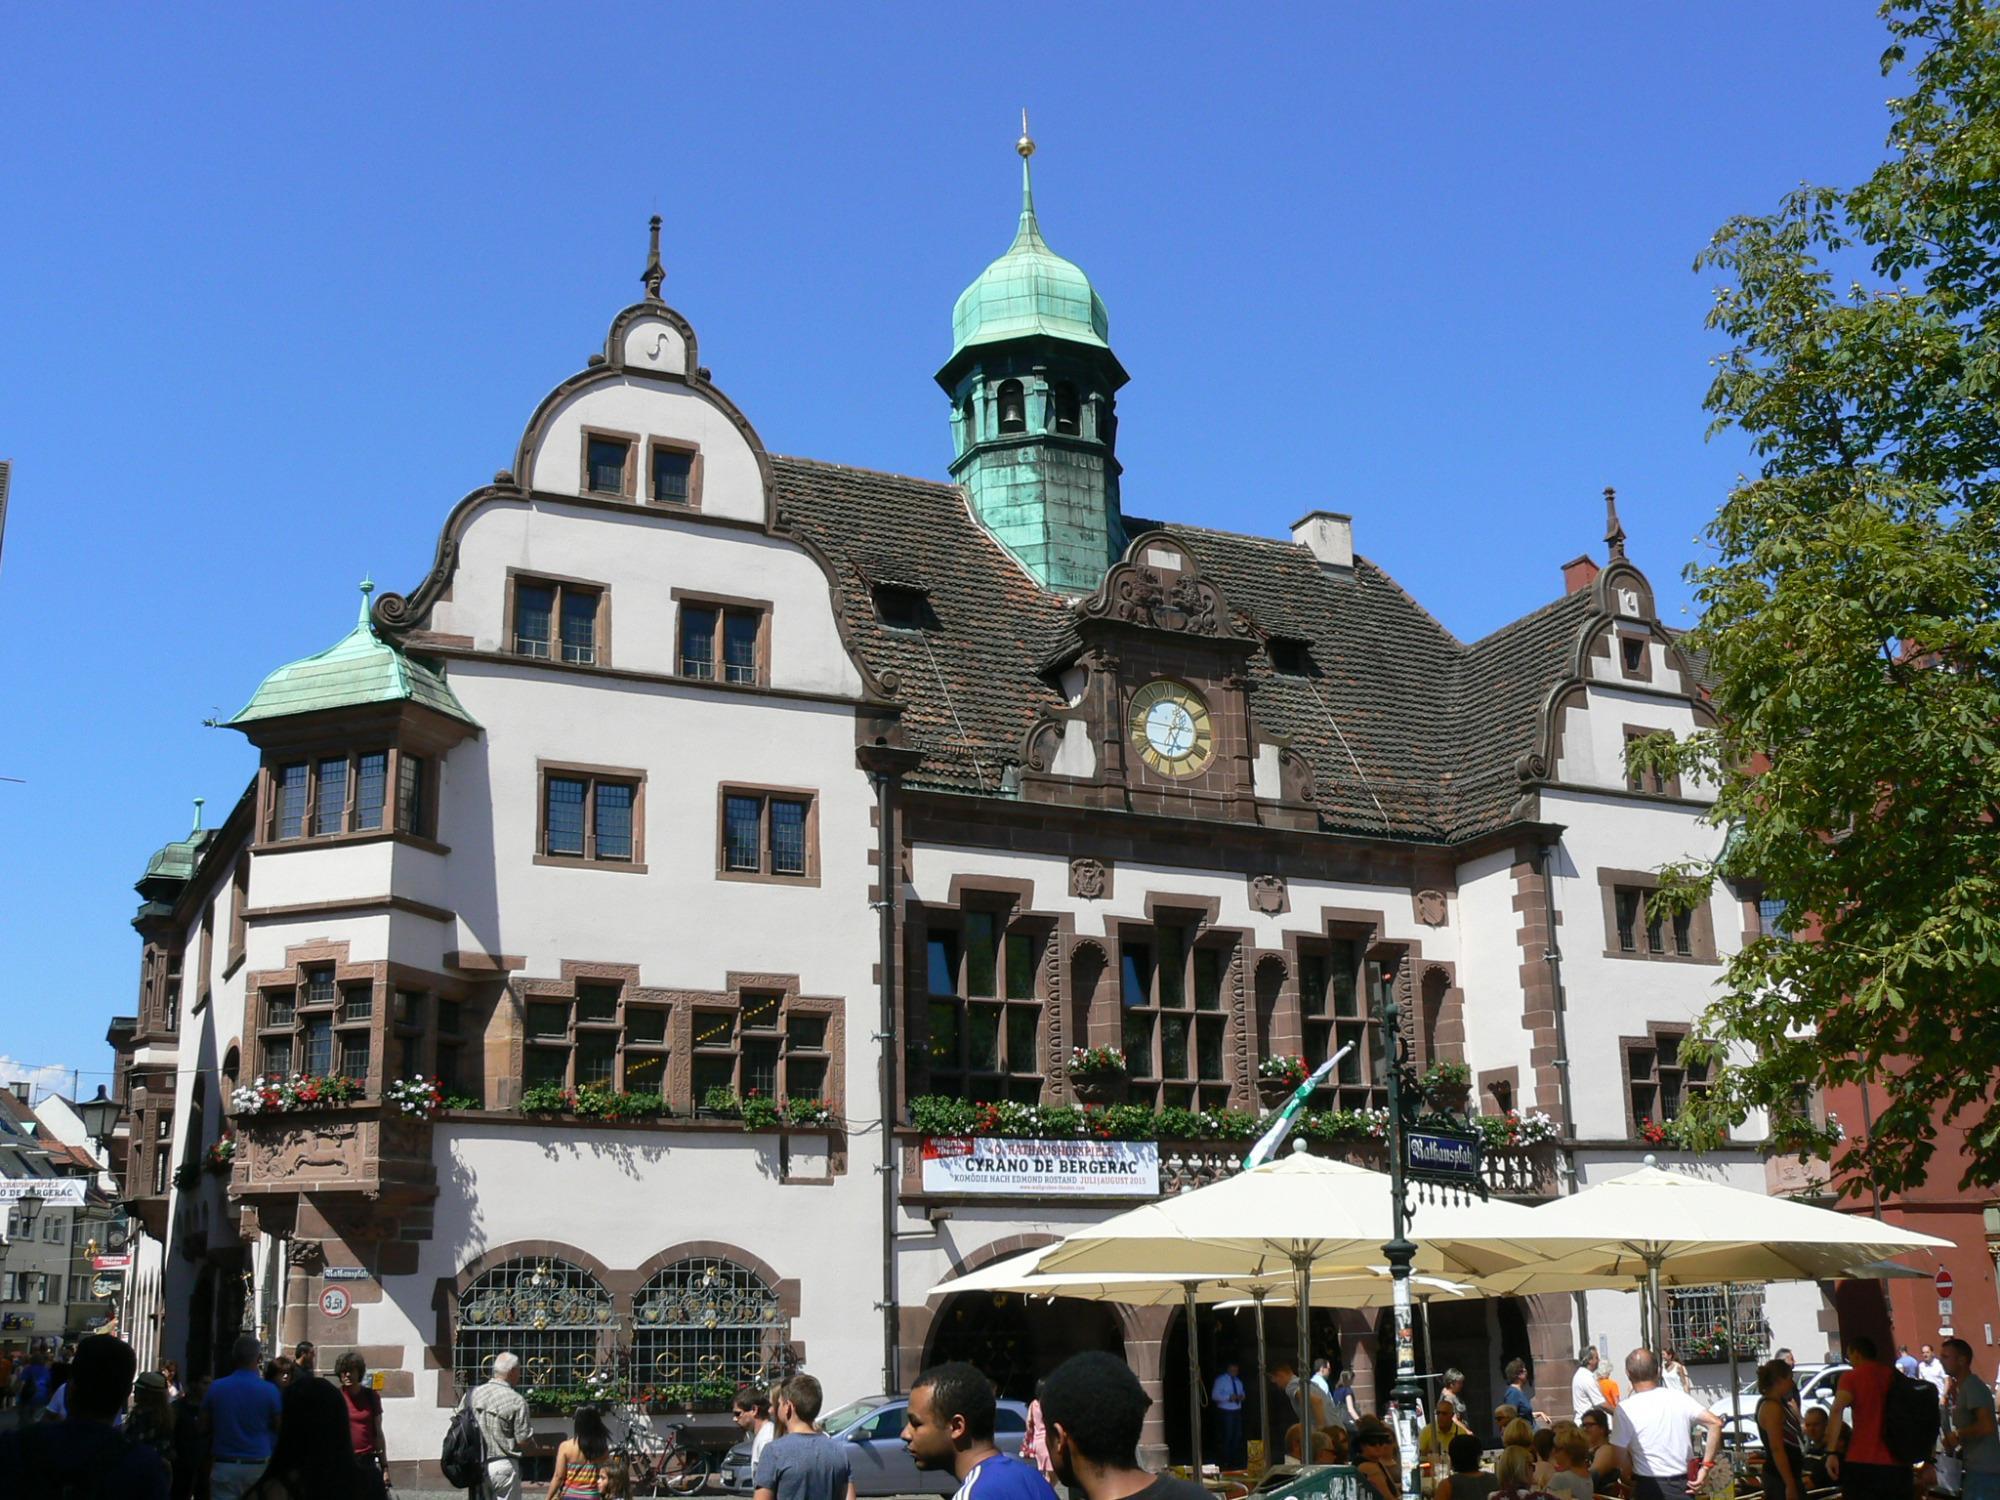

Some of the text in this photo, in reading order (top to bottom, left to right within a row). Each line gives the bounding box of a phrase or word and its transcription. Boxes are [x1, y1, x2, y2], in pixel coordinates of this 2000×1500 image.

[1008, 1144, 1114, 1158] RATHAUSHOFSPIELE
[965, 1157, 1138, 1175] CYRANO DE BERGERAC
[954, 1172, 988, 1183] KOMÖDIE
[989, 1174, 1010, 1184] NACH
[1011, 1174, 1043, 1184] EDMOND
[1044, 1175, 1078, 1185] ROSTAND
[1130, 1177, 1147, 1186] 2015
